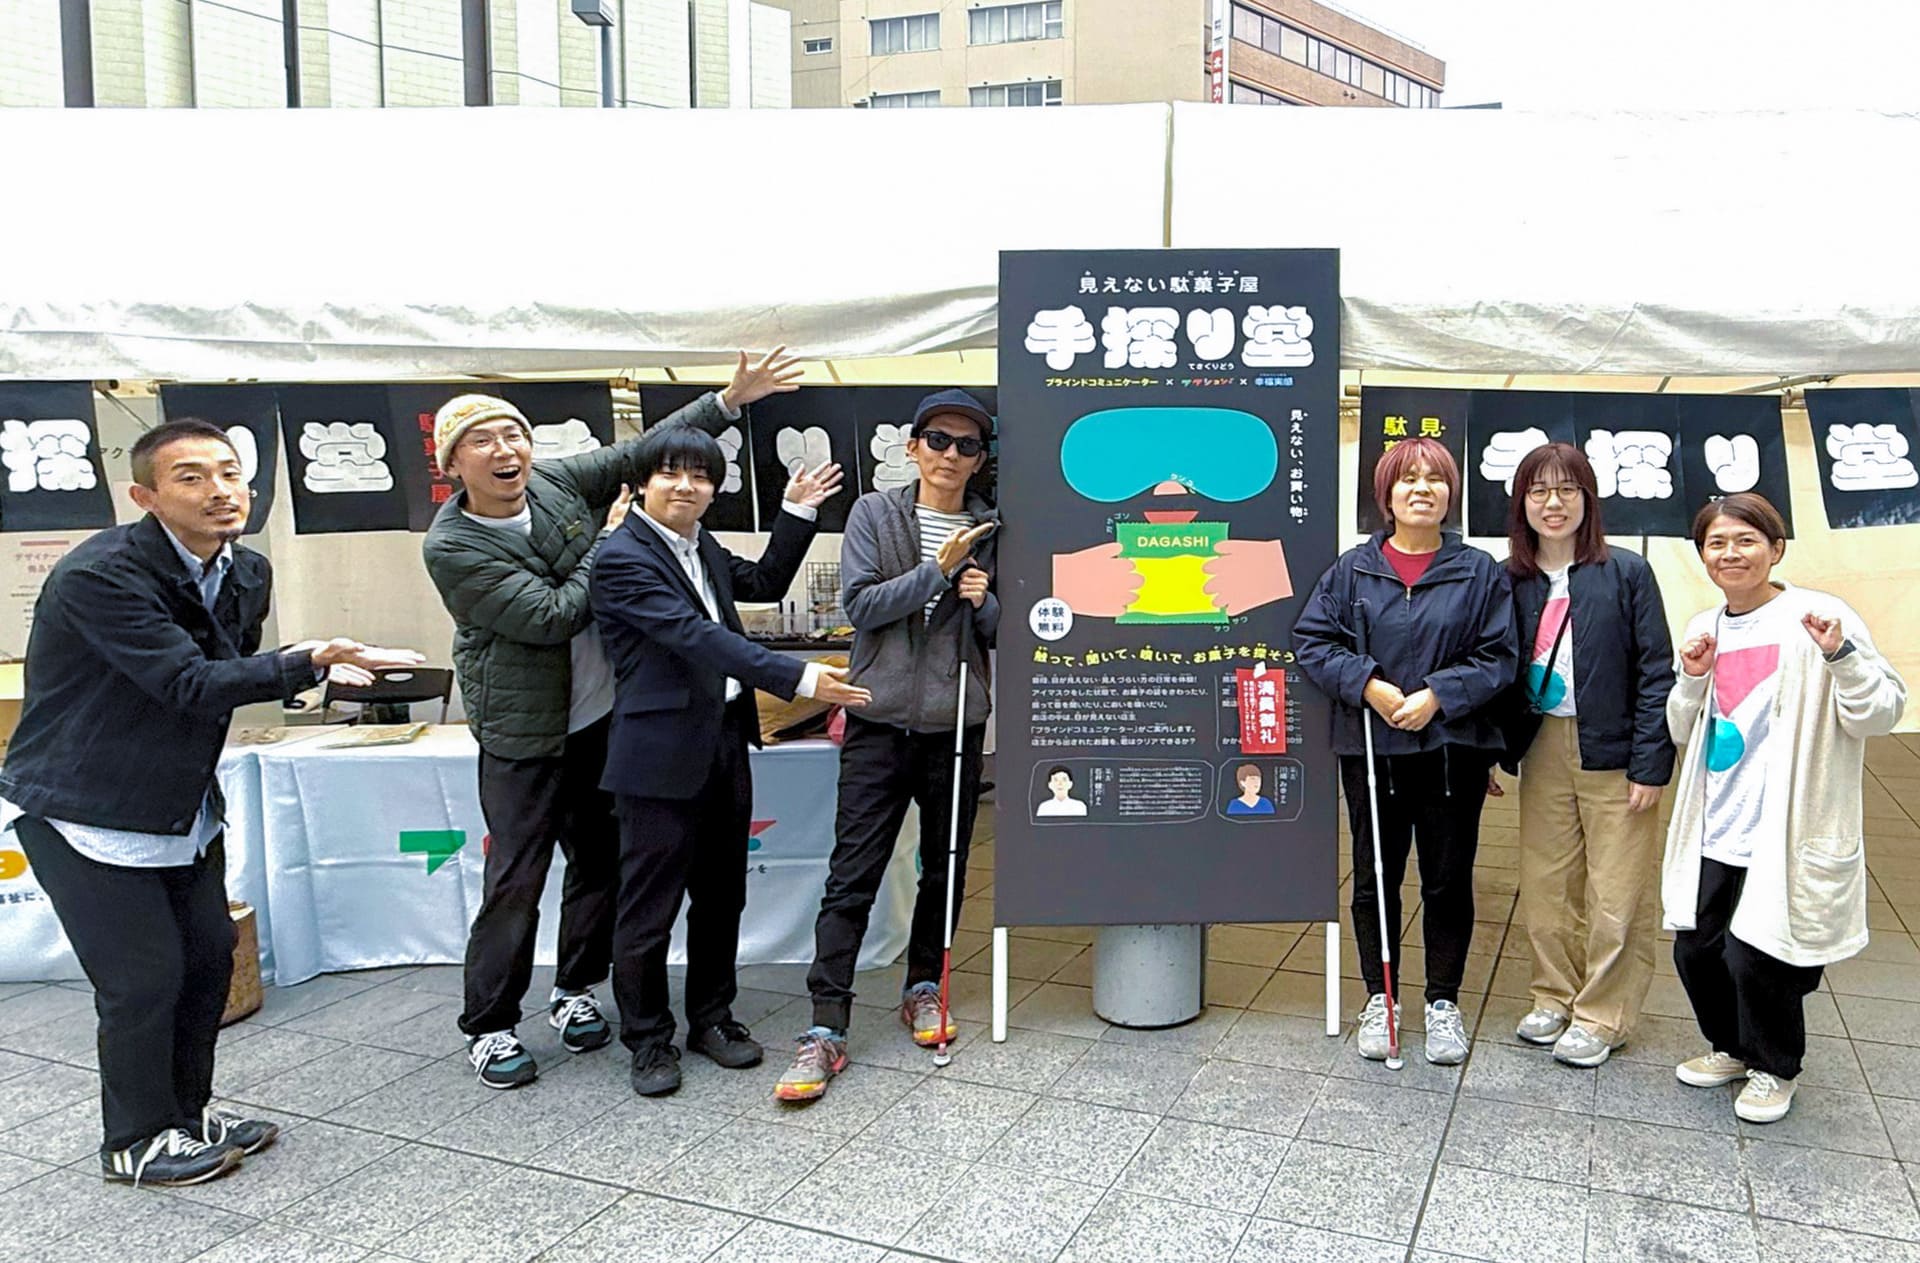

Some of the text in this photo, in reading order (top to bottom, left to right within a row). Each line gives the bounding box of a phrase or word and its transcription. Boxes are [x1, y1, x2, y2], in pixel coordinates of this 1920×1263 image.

[1078, 276, 1259, 294] 見えない駄菓子屋
[1024, 305, 1315, 371] 手探り堂
[1046, 377, 1159, 387] ブラインドコミュニケーター
[1137, 535, 1209, 548] DAGASHI
[1038, 606, 1064, 617] 体験
[1038, 622, 1064, 633] 無料
[1258, 680, 1277, 745] 満員御礼
